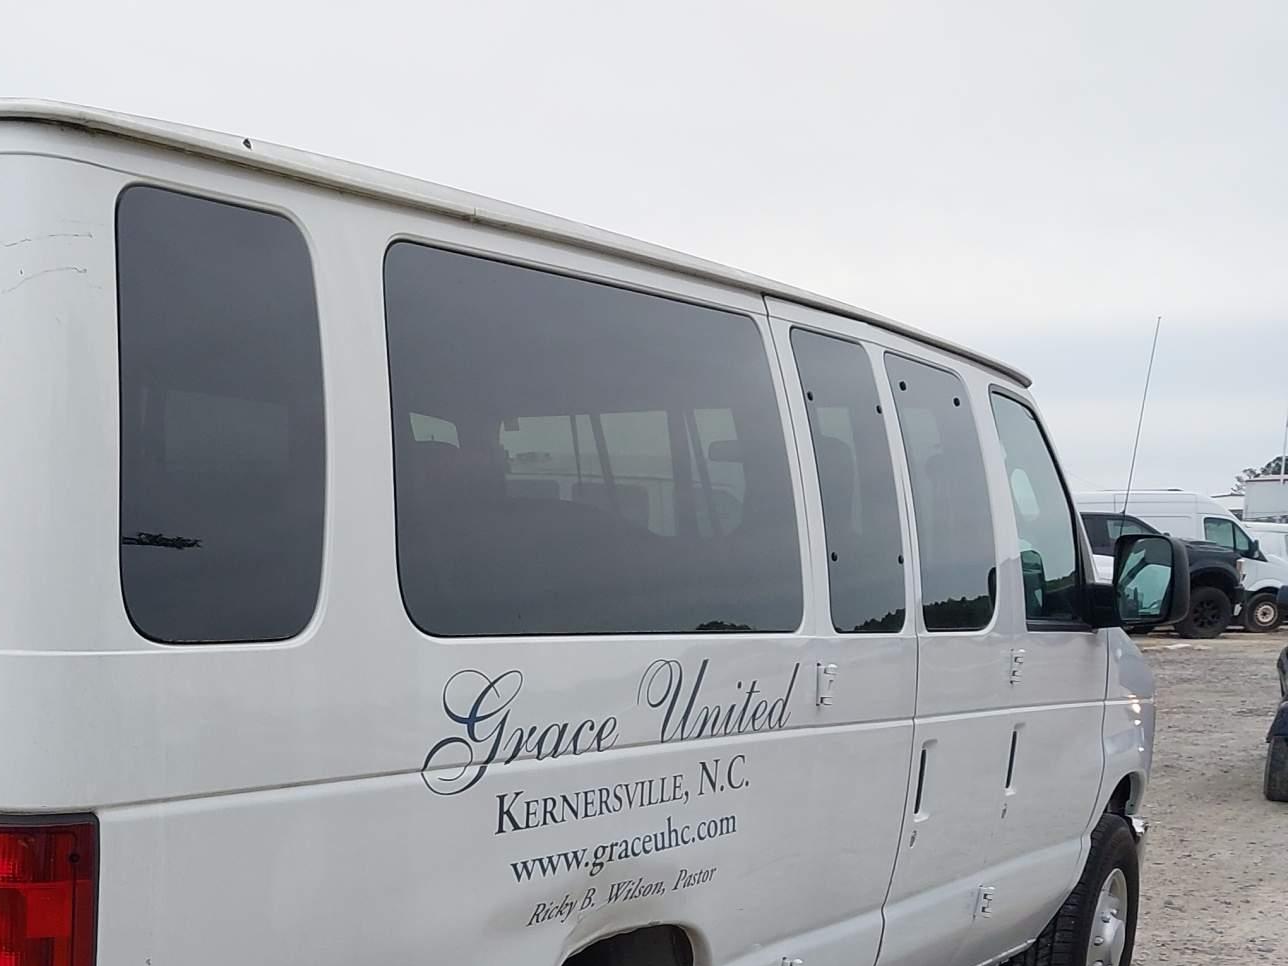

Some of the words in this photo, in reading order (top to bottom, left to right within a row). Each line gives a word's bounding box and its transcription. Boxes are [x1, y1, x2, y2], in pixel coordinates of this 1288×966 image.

[421, 670, 619, 796] Grace
[637, 658, 800, 744] United
[494, 774, 690, 835] KERNERSVILLE,
[698, 754, 751, 796] N.C.
[510, 812, 738, 884] www.graceuhc.com
[526, 891, 578, 928] Ricky
[577, 887, 596, 911] B.
[607, 877, 667, 906] Wilson,
[672, 865, 718, 893] Pastor
